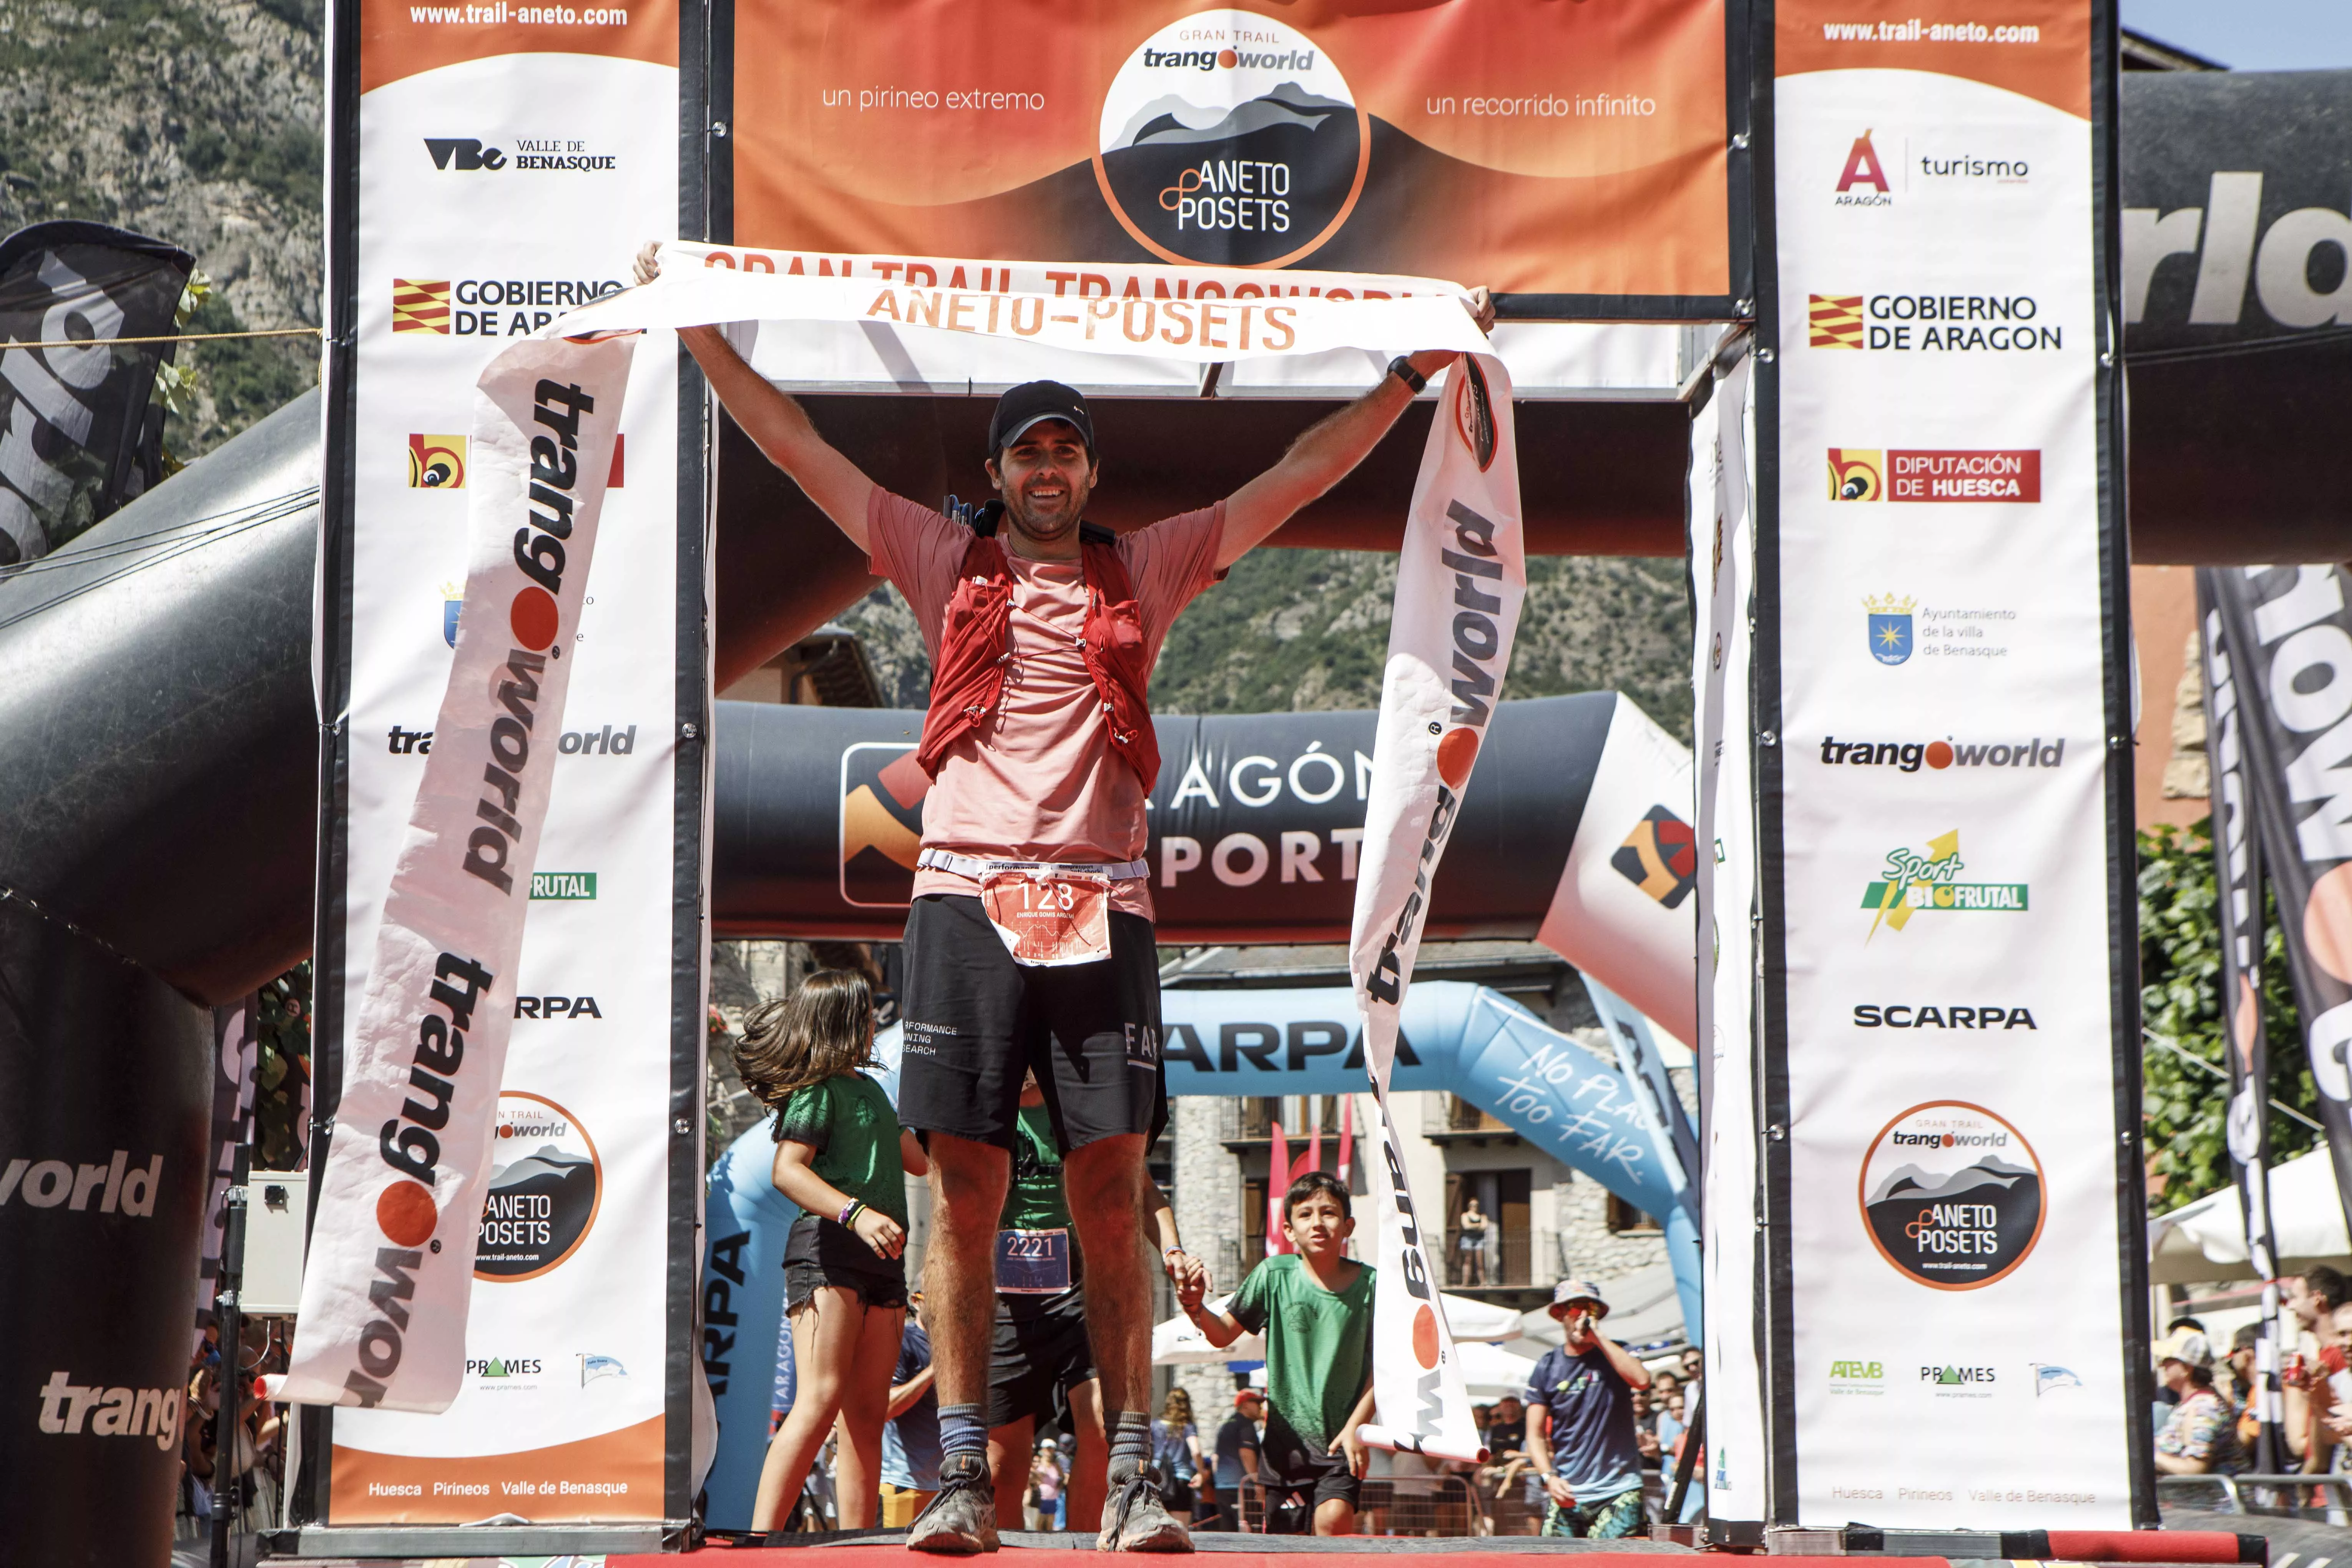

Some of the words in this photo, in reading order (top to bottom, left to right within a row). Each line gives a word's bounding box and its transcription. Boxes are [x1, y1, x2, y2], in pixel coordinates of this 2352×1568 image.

[410, 3, 628, 26] www.trail-aneto.com
[1179, 30, 1225, 42] GRAN
[1233, 31, 1279, 43] TRAIL
[1824, 20, 2040, 43] www.trail-aneto.com
[823, 88, 851, 107] un
[860, 85, 938, 111] pirineo
[946, 88, 1045, 110] extremo
[1427, 96, 1455, 115] un
[1463, 93, 1569, 117] recorrido
[1576, 94, 1656, 116] infinito
[517, 140, 561, 152] VALLE
[568, 141, 585, 152] DE
[516, 156, 616, 172] BENASQUE
[1922, 155, 2029, 176] turismo
[1200, 160, 1289, 196] ANETO
[1835, 193, 1892, 206] ARAGÓN
[1178, 197, 1290, 232] POSETS
[1870, 295, 2036, 320] GOBIERNO
[456, 311, 498, 336] DE
[1870, 327, 1910, 350] DE
[1921, 327, 2062, 350] ARAGON
[1896, 453, 2021, 475] DIPUTACIÓN
[1897, 479, 1924, 496] DE
[1932, 479, 2021, 497] HUESCA
[1922, 607, 2016, 623] Ayuntamiento
[1923, 625, 1939, 637] de
[1943, 625, 1954, 637] la
[1957, 626, 1983, 638] villa
[1923, 644, 1940, 656] de
[1943, 645, 2007, 658] Benasque
[1145, 741, 1374, 809] AGÓ
[1159, 827, 1364, 887] PORT
[1882, 848, 1964, 889] Sport
[1854, 1005, 2038, 1030] SCARPA
[1520, 1043, 1574, 1085] NO
[1495, 1076, 1553, 1125] TOO
[512, 1111, 543, 1119] TRAIL
[1915, 1119, 1946, 1129] GRAN
[1953, 1120, 1983, 1129] TRAIL
[488, 1195, 551, 1219] ANETO
[1932, 1204, 1997, 1229] ANETO
[1007, 1237, 1052, 1256] 2221
[1918, 1230, 1998, 1254] POSETS
[1922, 1261, 1988, 1270] www.trail-aneto.com
[704, 1231, 751, 1396] RPA
[1829, 1360, 1883, 1379] ATEVB
[38, 1372, 186, 1451] trang
[369, 1482, 421, 1496] Huesca
[433, 1482, 490, 1496] Pirineos
[502, 1481, 536, 1495] Valle
[539, 1481, 556, 1494] de
[560, 1480, 628, 1498] Benasque
[1832, 1487, 1883, 1500] Huesca
[1899, 1487, 1953, 1501] Pirineos
[1968, 1489, 2003, 1502] Valle
[2005, 1489, 2023, 1502] de
[2027, 1490, 2096, 1506] Benasque
